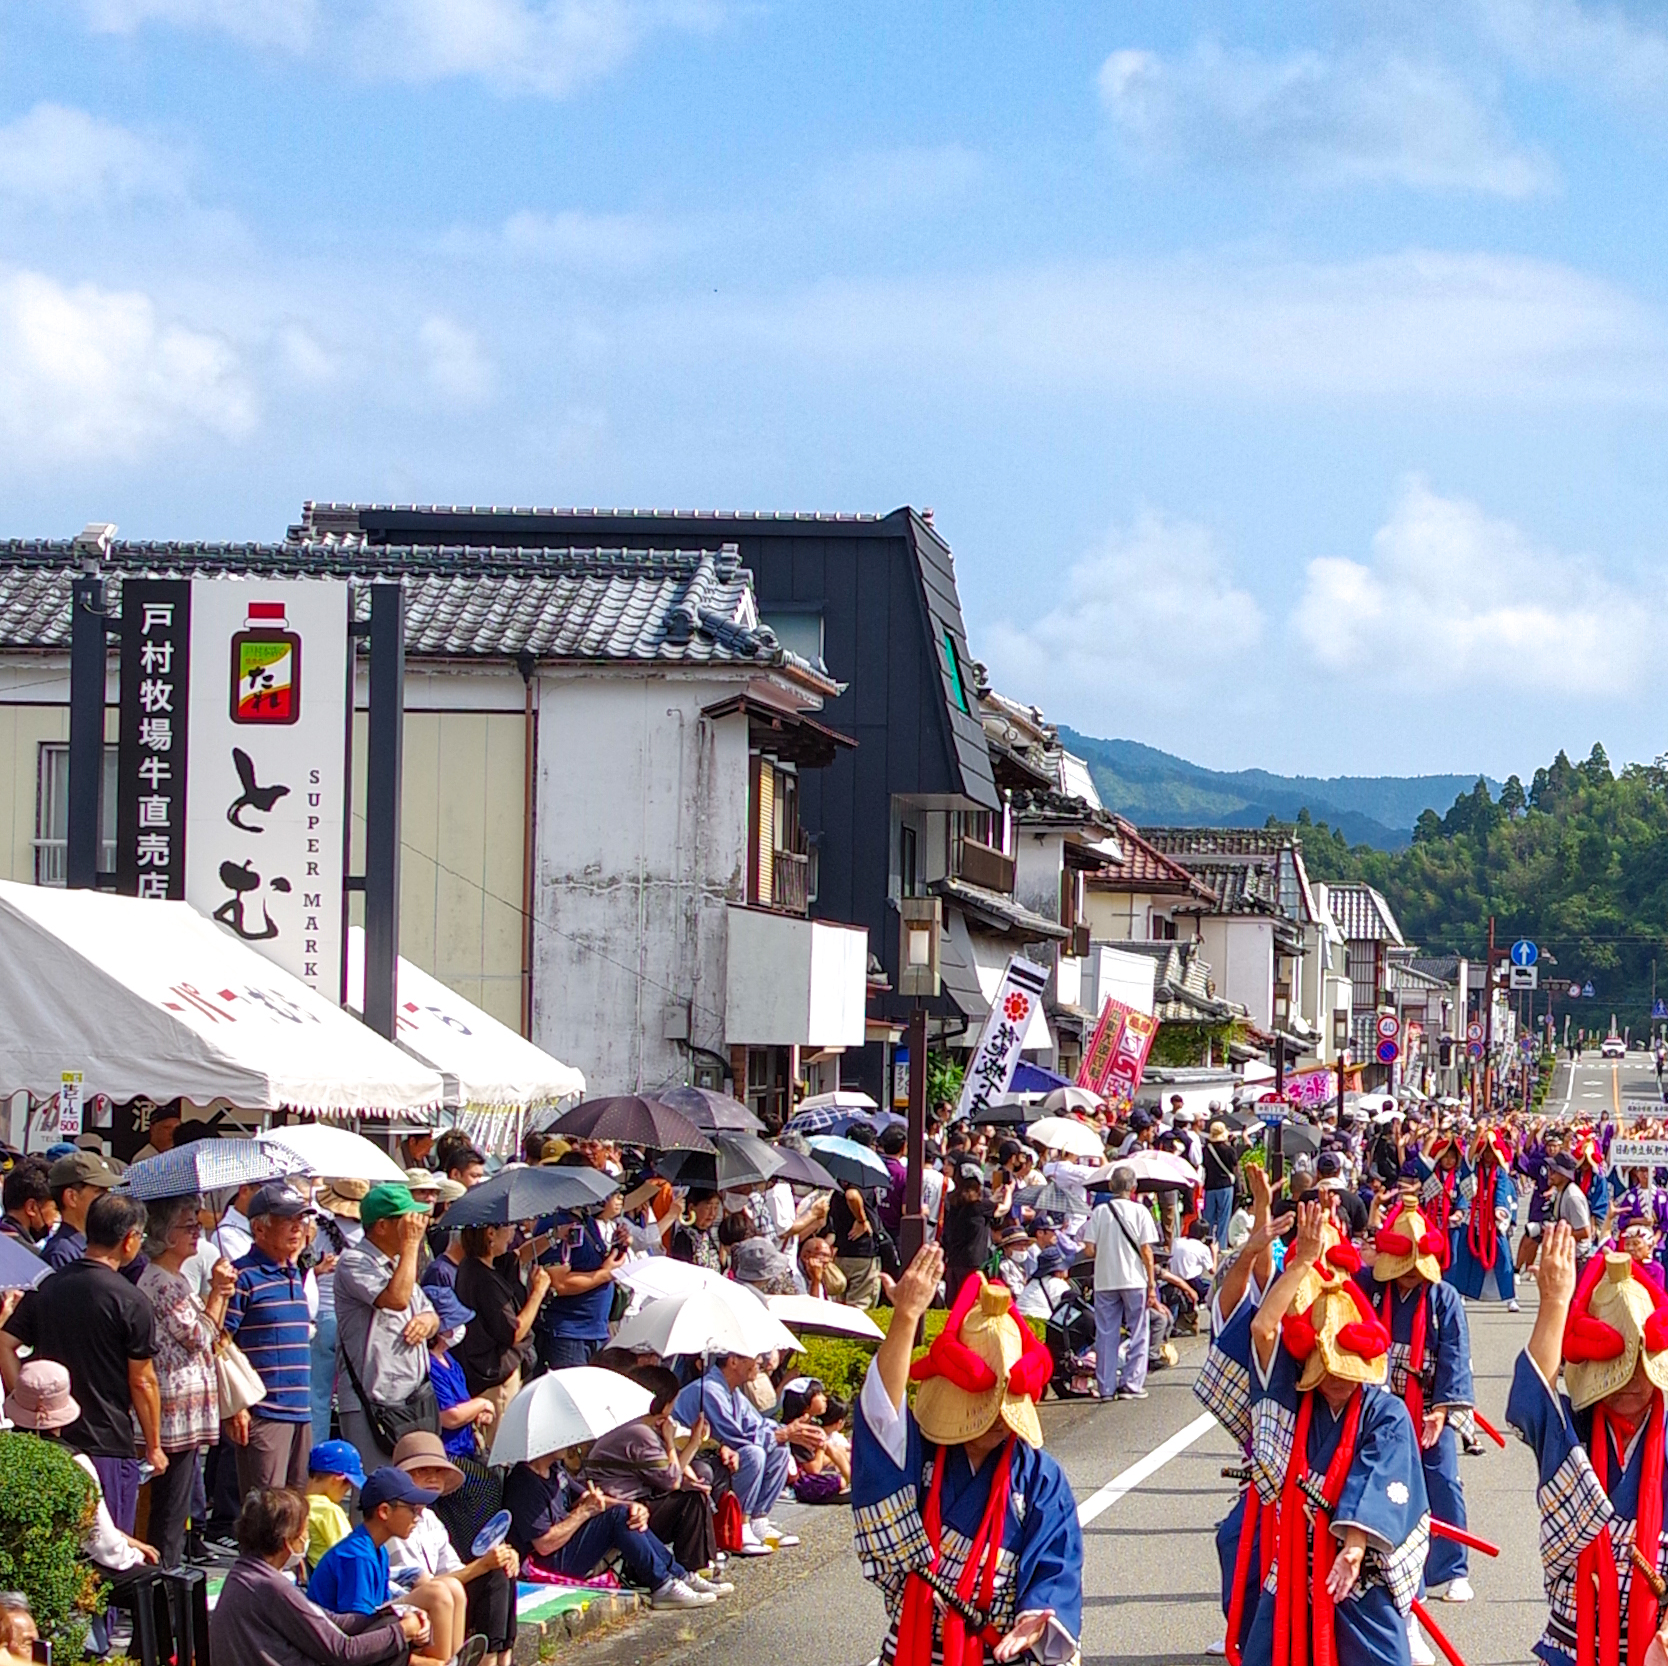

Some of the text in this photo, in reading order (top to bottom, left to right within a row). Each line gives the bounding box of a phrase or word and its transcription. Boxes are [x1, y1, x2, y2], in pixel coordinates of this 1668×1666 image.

[137, 602, 176, 900] 戸村牧場牛直売店
[303, 770, 322, 989] SUPER MARK
[1382, 1021, 1395, 1032] 40
[60, 1120, 79, 1132] 500
